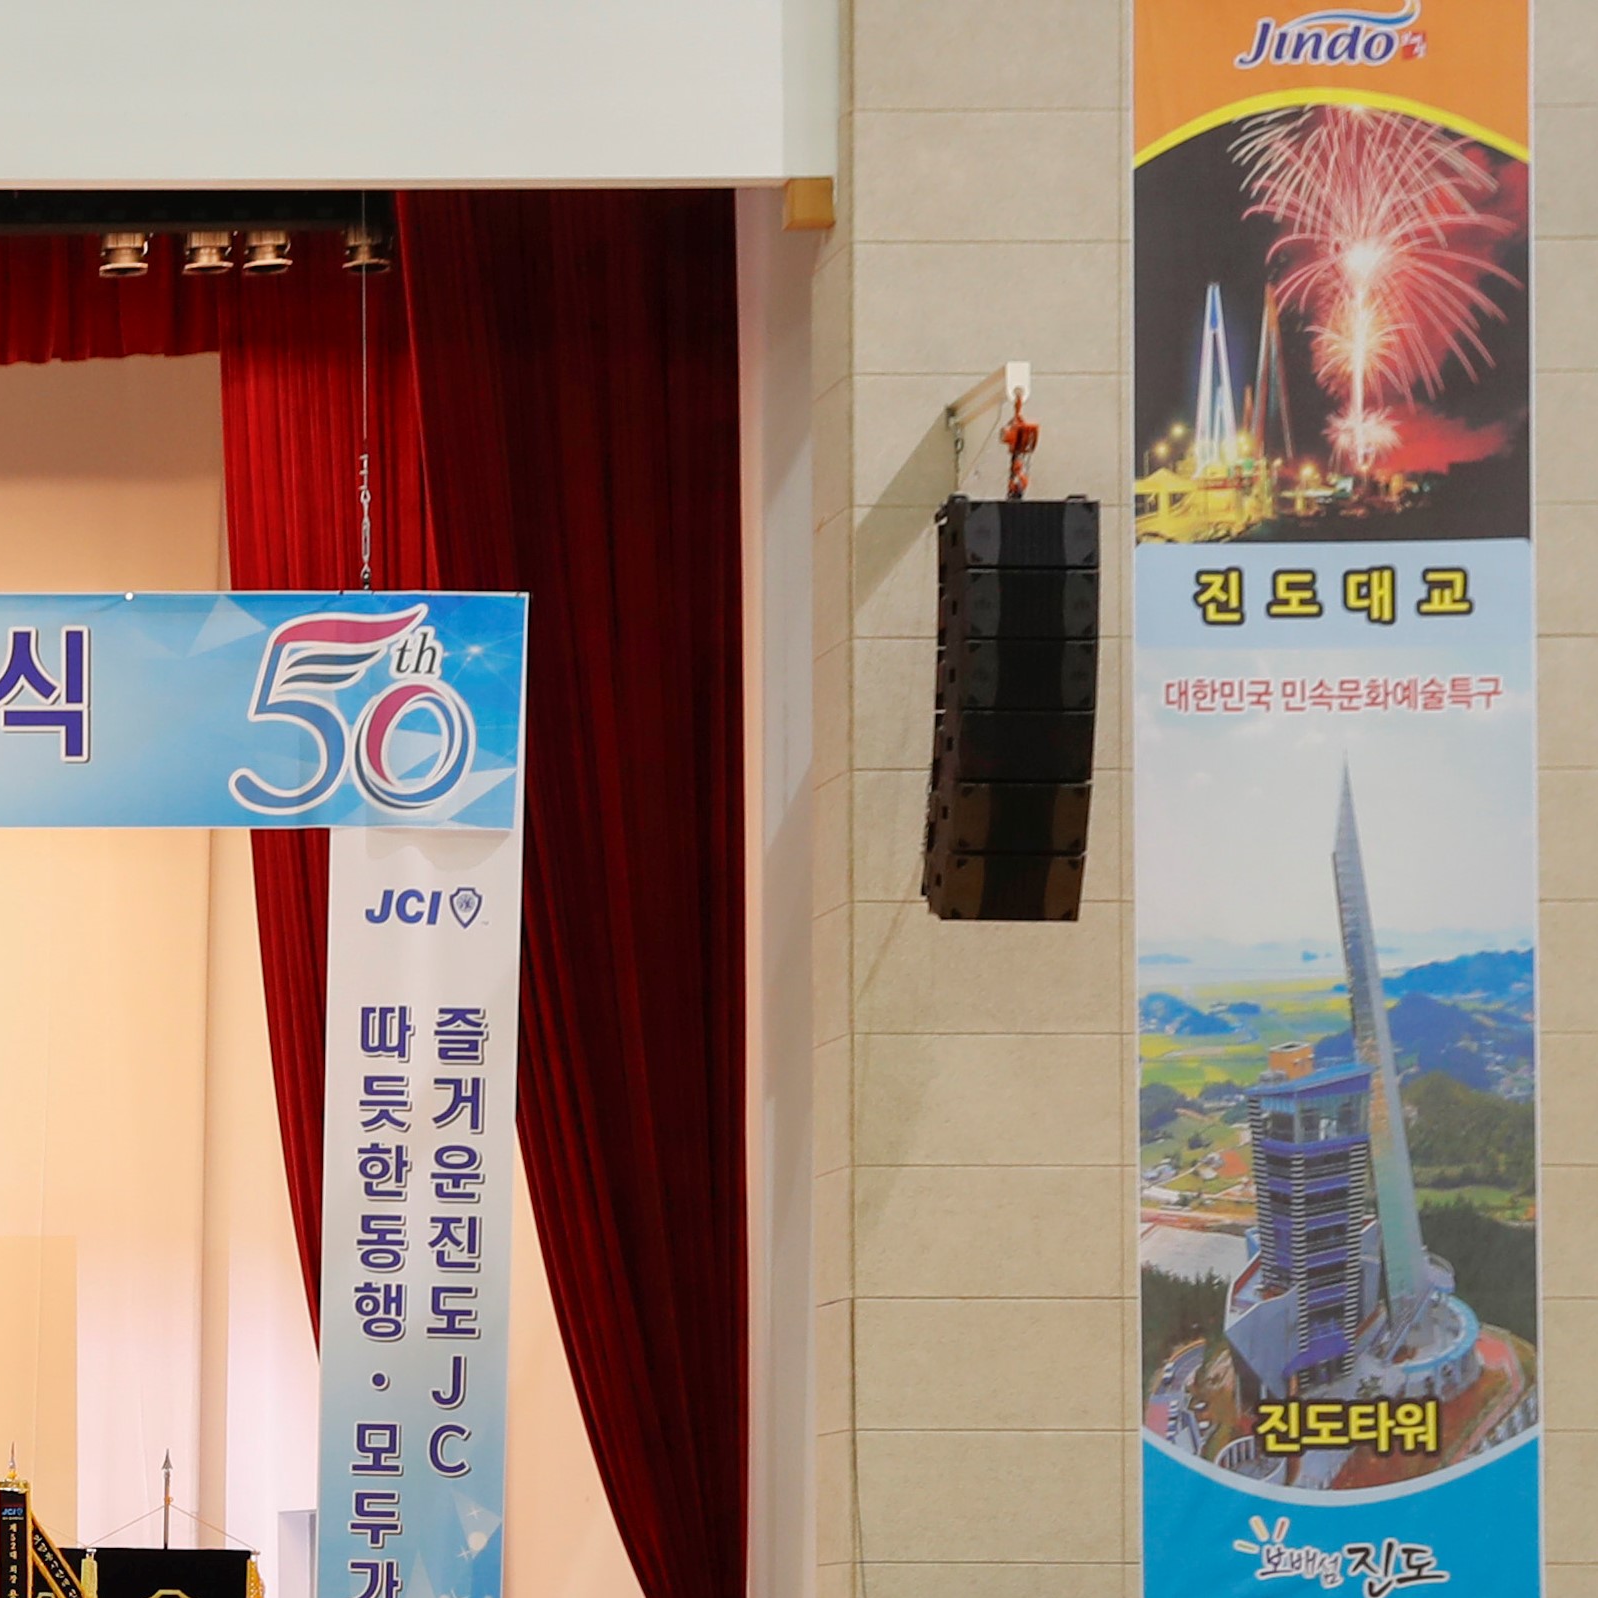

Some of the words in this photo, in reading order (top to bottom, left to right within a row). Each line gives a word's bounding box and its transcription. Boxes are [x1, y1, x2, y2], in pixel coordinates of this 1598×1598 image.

[1237, 20, 1396, 67] Jindo
[1164, 679, 1273, 712] 대한민국
[1282, 676, 1503, 711] 민속문화예술특구
[365, 889, 442, 925] JCI
[1255, 1400, 1439, 1452] 진도타워
[1259, 1546, 1340, 1584] 보배섬
[1346, 1541, 1446, 1598] 진도
